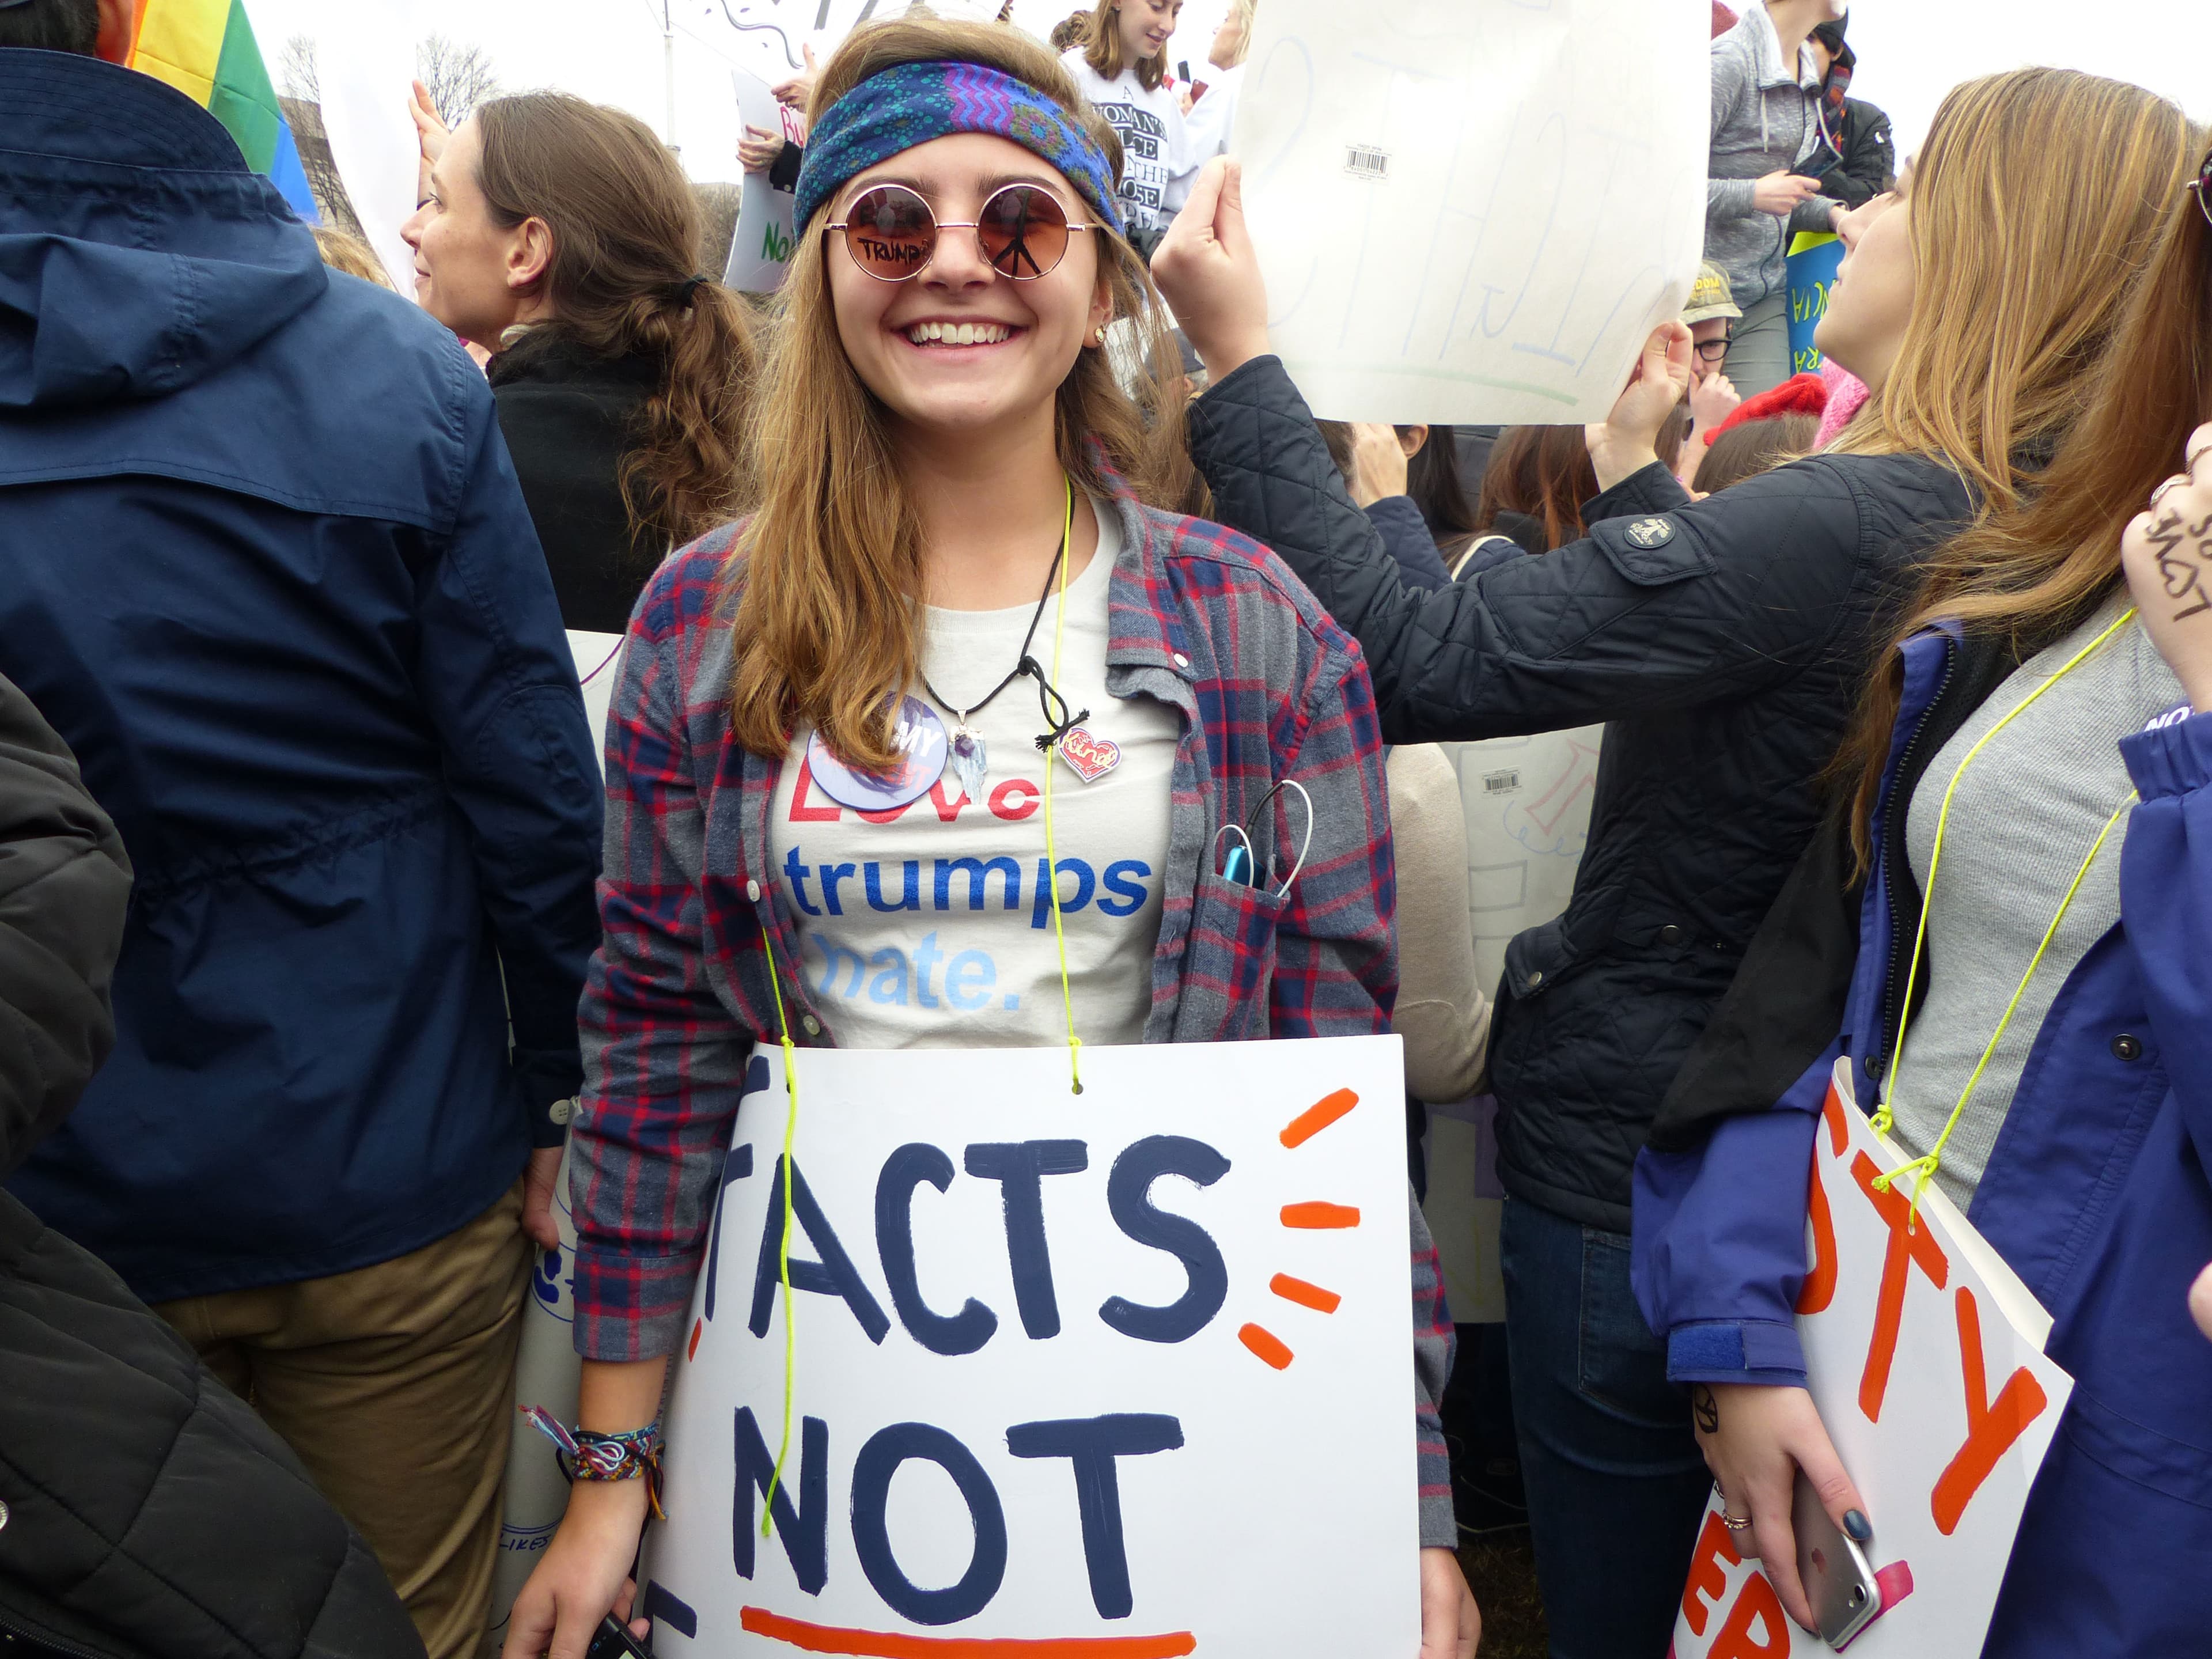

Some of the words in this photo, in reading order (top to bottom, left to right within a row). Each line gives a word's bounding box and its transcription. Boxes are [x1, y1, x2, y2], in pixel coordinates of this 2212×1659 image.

[1122, 86, 1134, 101] A
[857, 236, 921, 264] TRUMP
[891, 721, 943, 757] MY
[784, 846, 1152, 929] trumps
[810, 930, 1020, 1011] hate.
[704, 1055, 1232, 1356] FACTS
[733, 1406, 1184, 1626] NOT
